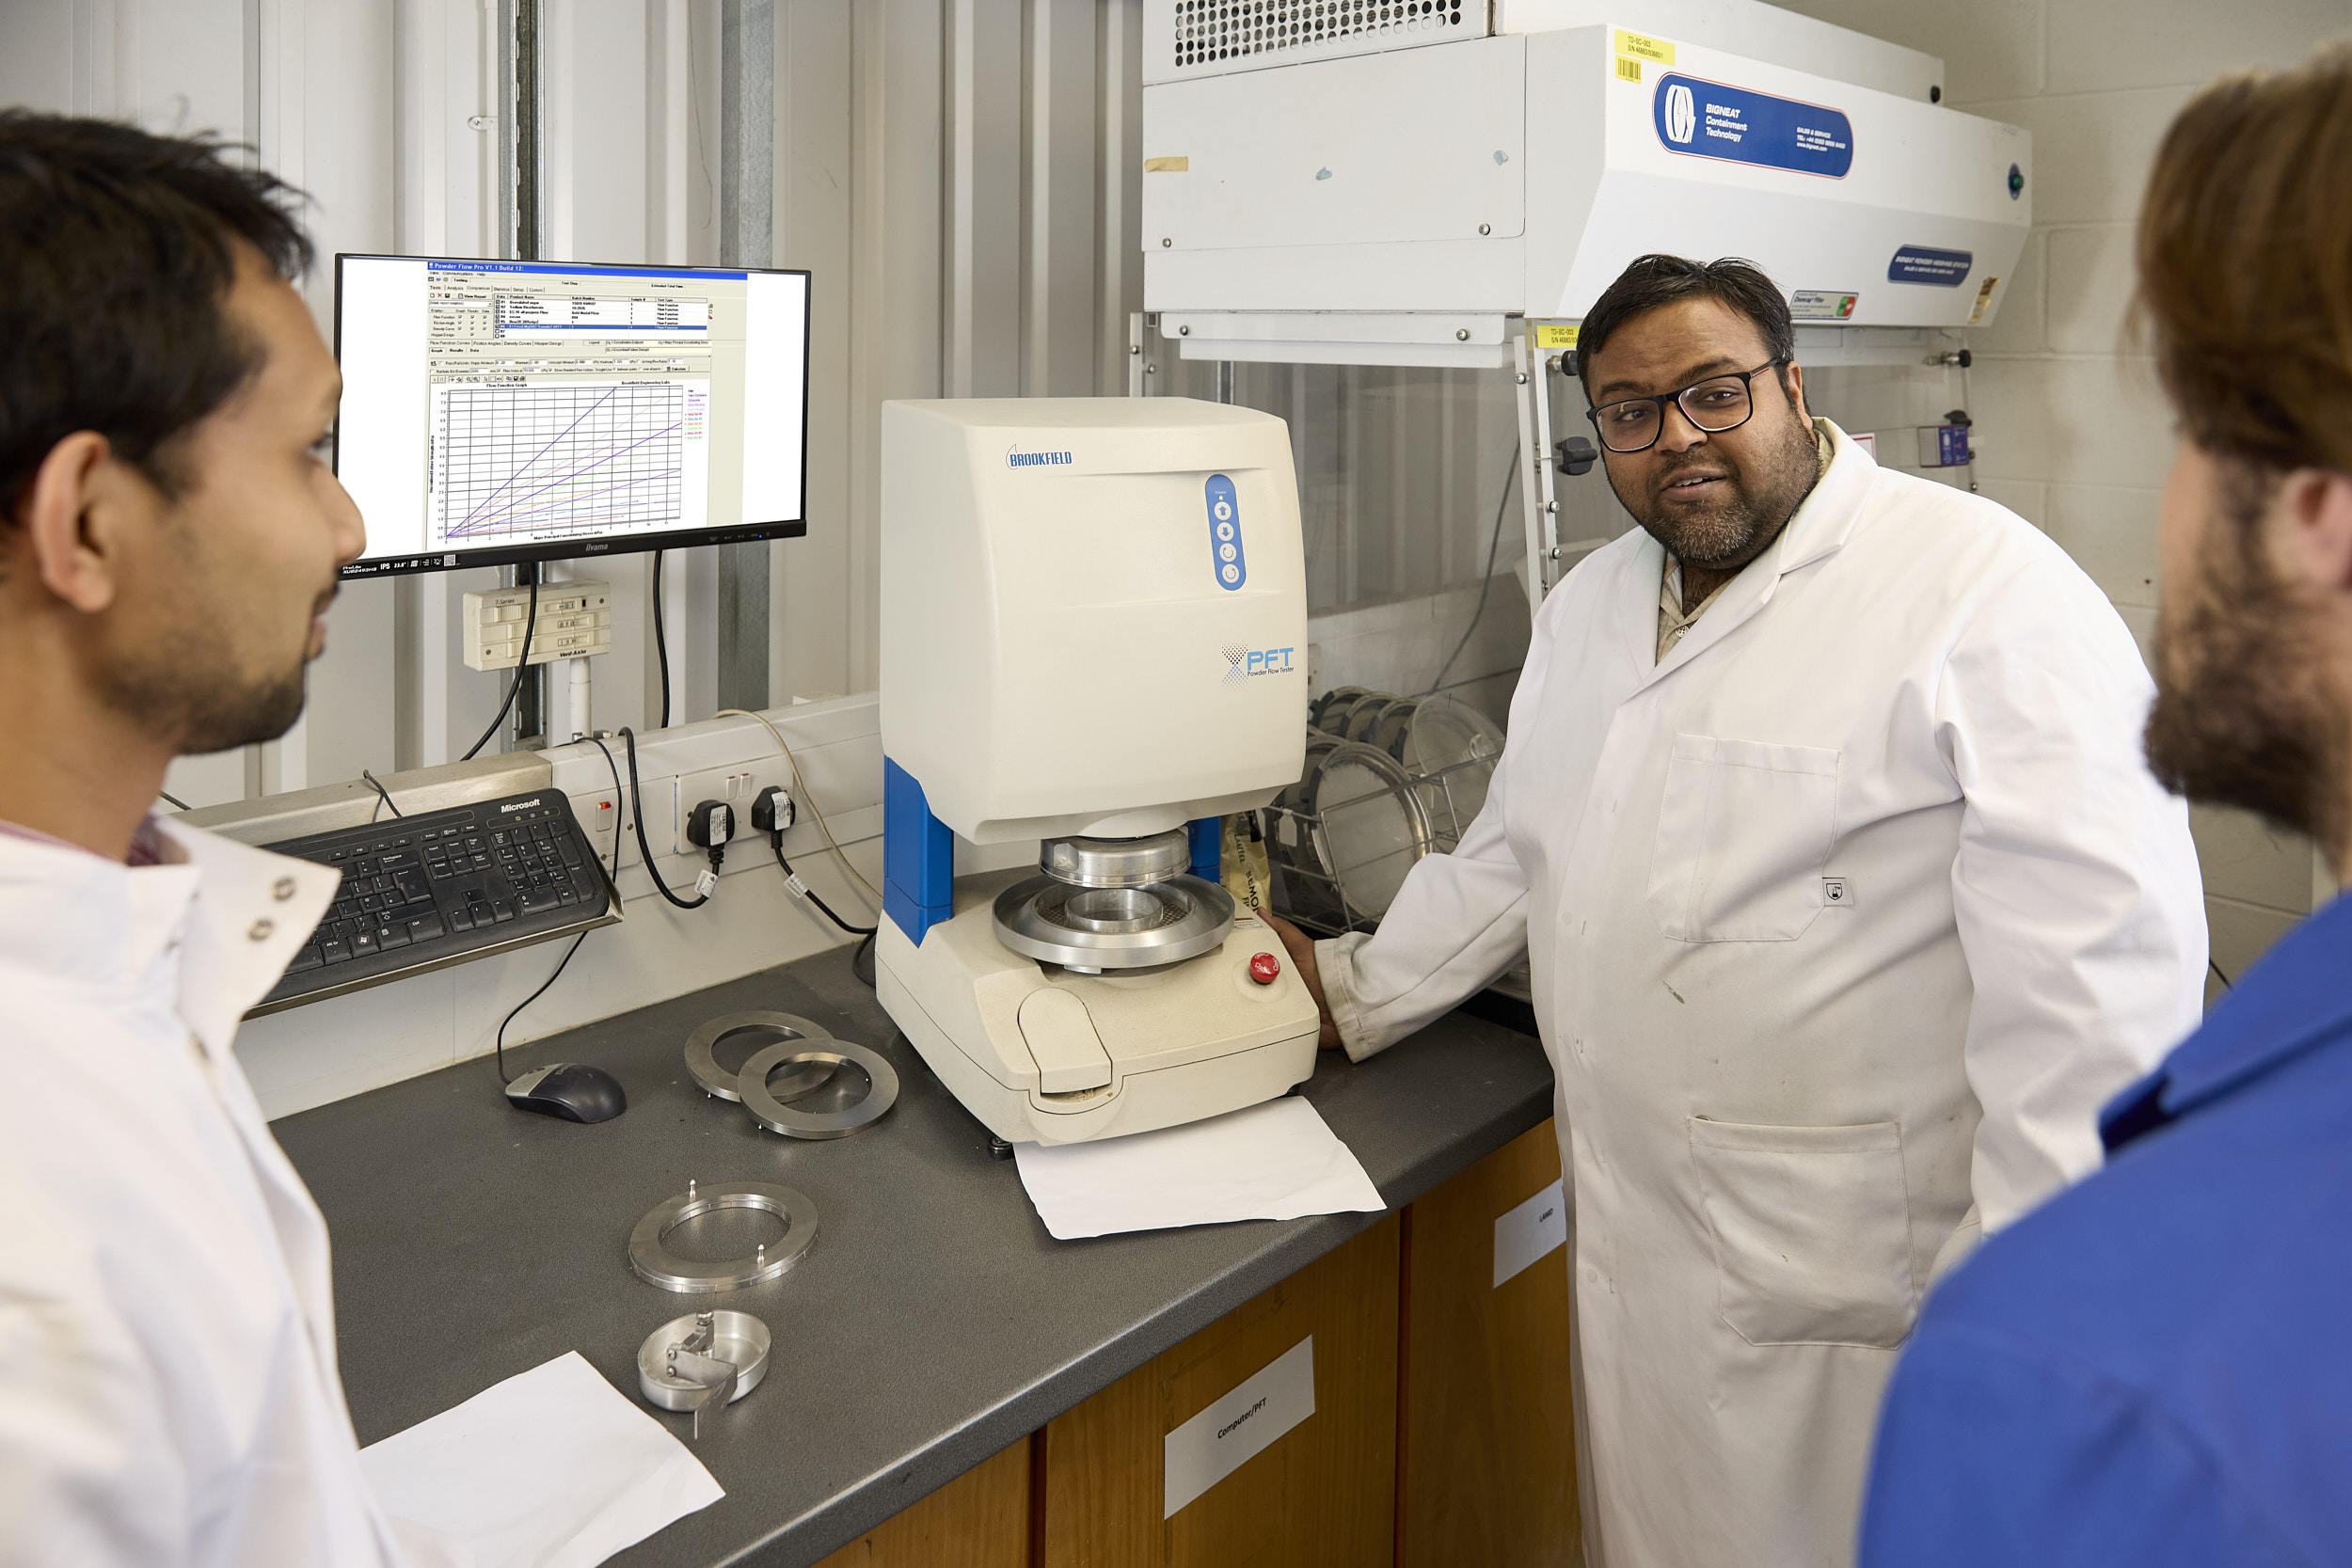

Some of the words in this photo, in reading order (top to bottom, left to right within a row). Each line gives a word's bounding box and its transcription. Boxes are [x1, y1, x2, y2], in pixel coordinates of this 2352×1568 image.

[1705, 103, 1740, 119] BIGNEAT
[1705, 116, 1748, 131] Containment
[1705, 127, 1742, 143] Technology
[1796, 127, 1810, 135] SALES
[1814, 130, 1831, 138] SERVICE
[1010, 451, 1072, 467] BROOKFIELD
[560, 649, 587, 657] Vent-Axia
[1247, 647, 1294, 671] PFT
[501, 799, 540, 813] Microsoft
[1218, 1397, 1267, 1439] Computer/PFT
